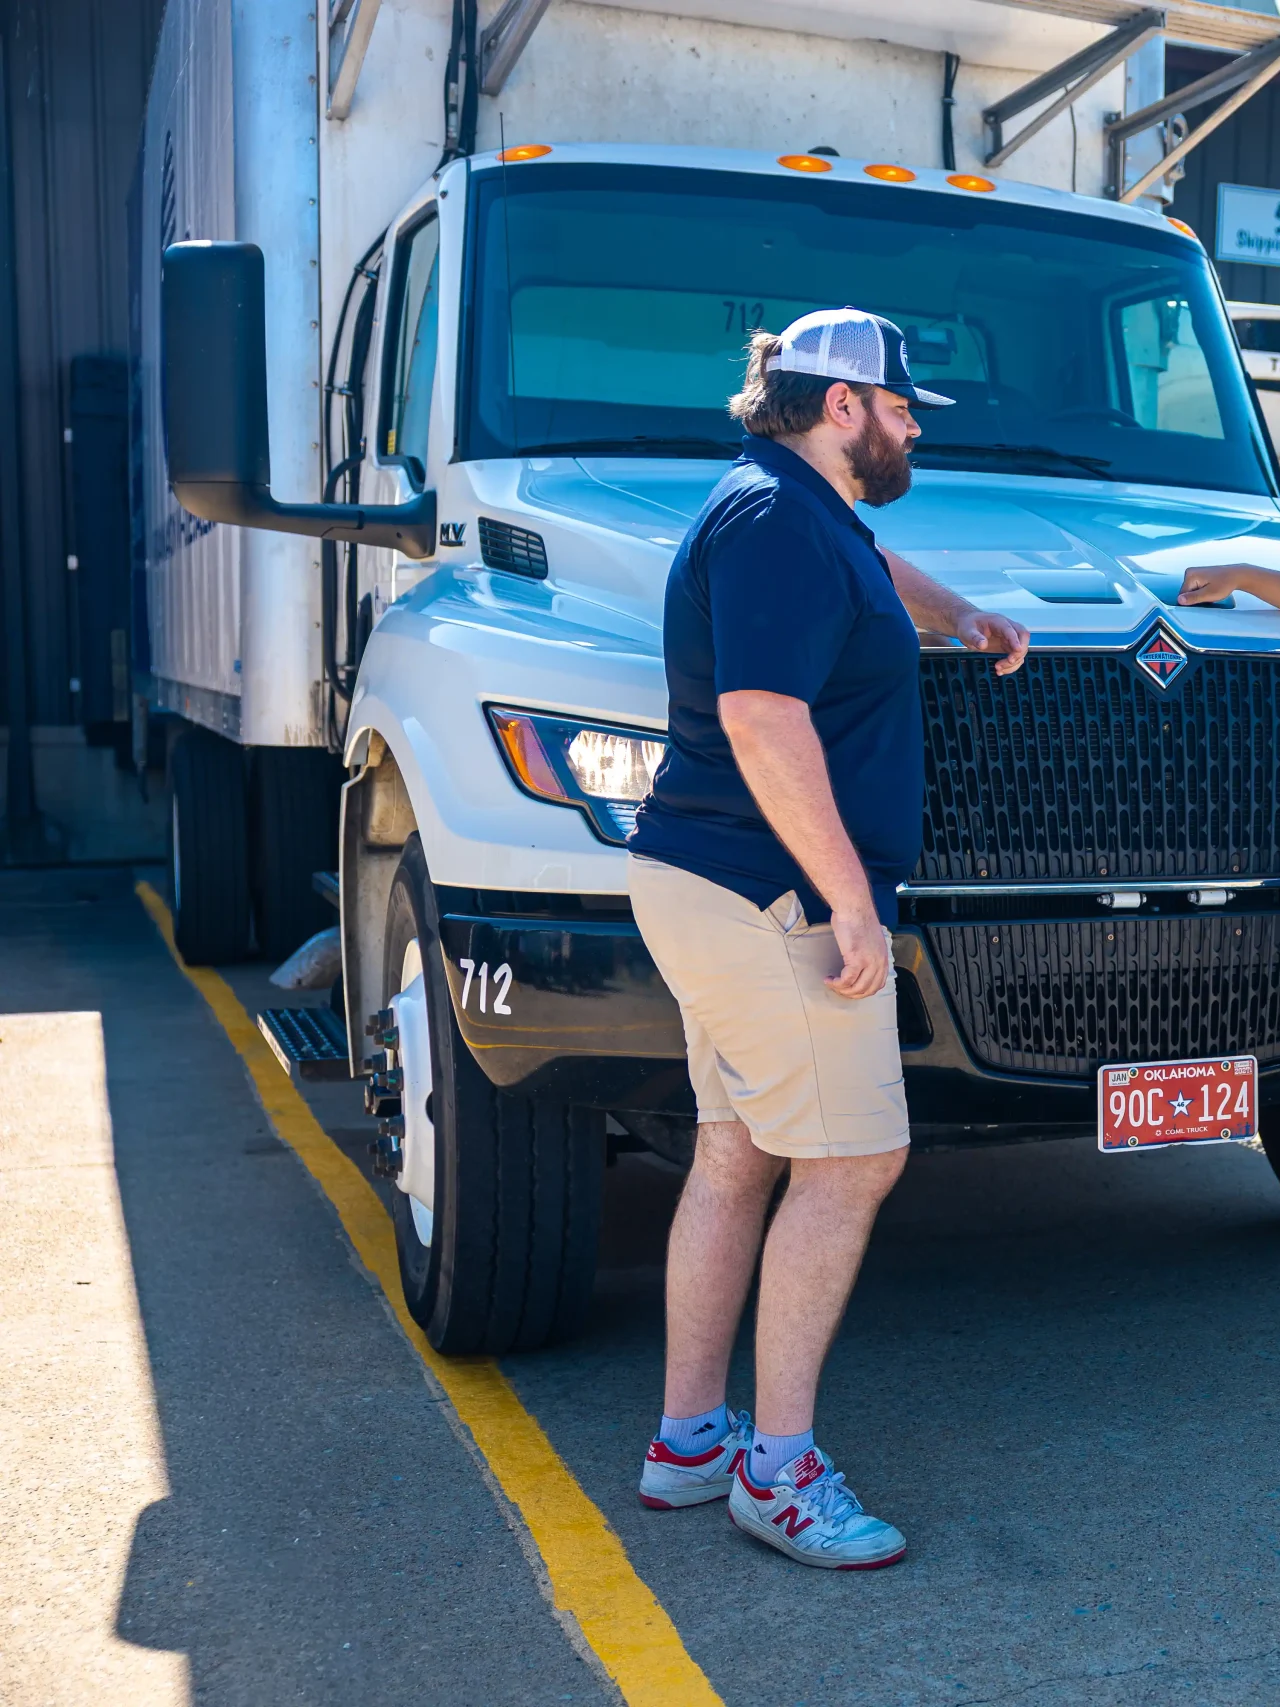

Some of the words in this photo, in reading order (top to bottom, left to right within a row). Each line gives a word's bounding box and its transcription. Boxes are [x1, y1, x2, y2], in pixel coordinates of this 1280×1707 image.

[722, 301, 764, 333] 712
[440, 522, 467, 544] MV
[460, 958, 512, 1015] 712
[1111, 1073, 1127, 1082] JAN
[1144, 1066, 1215, 1082] OKLAHOMA
[1109, 1088, 1164, 1128] 90C
[1198, 1081, 1249, 1122] 124
[771, 1504, 815, 1539] N
